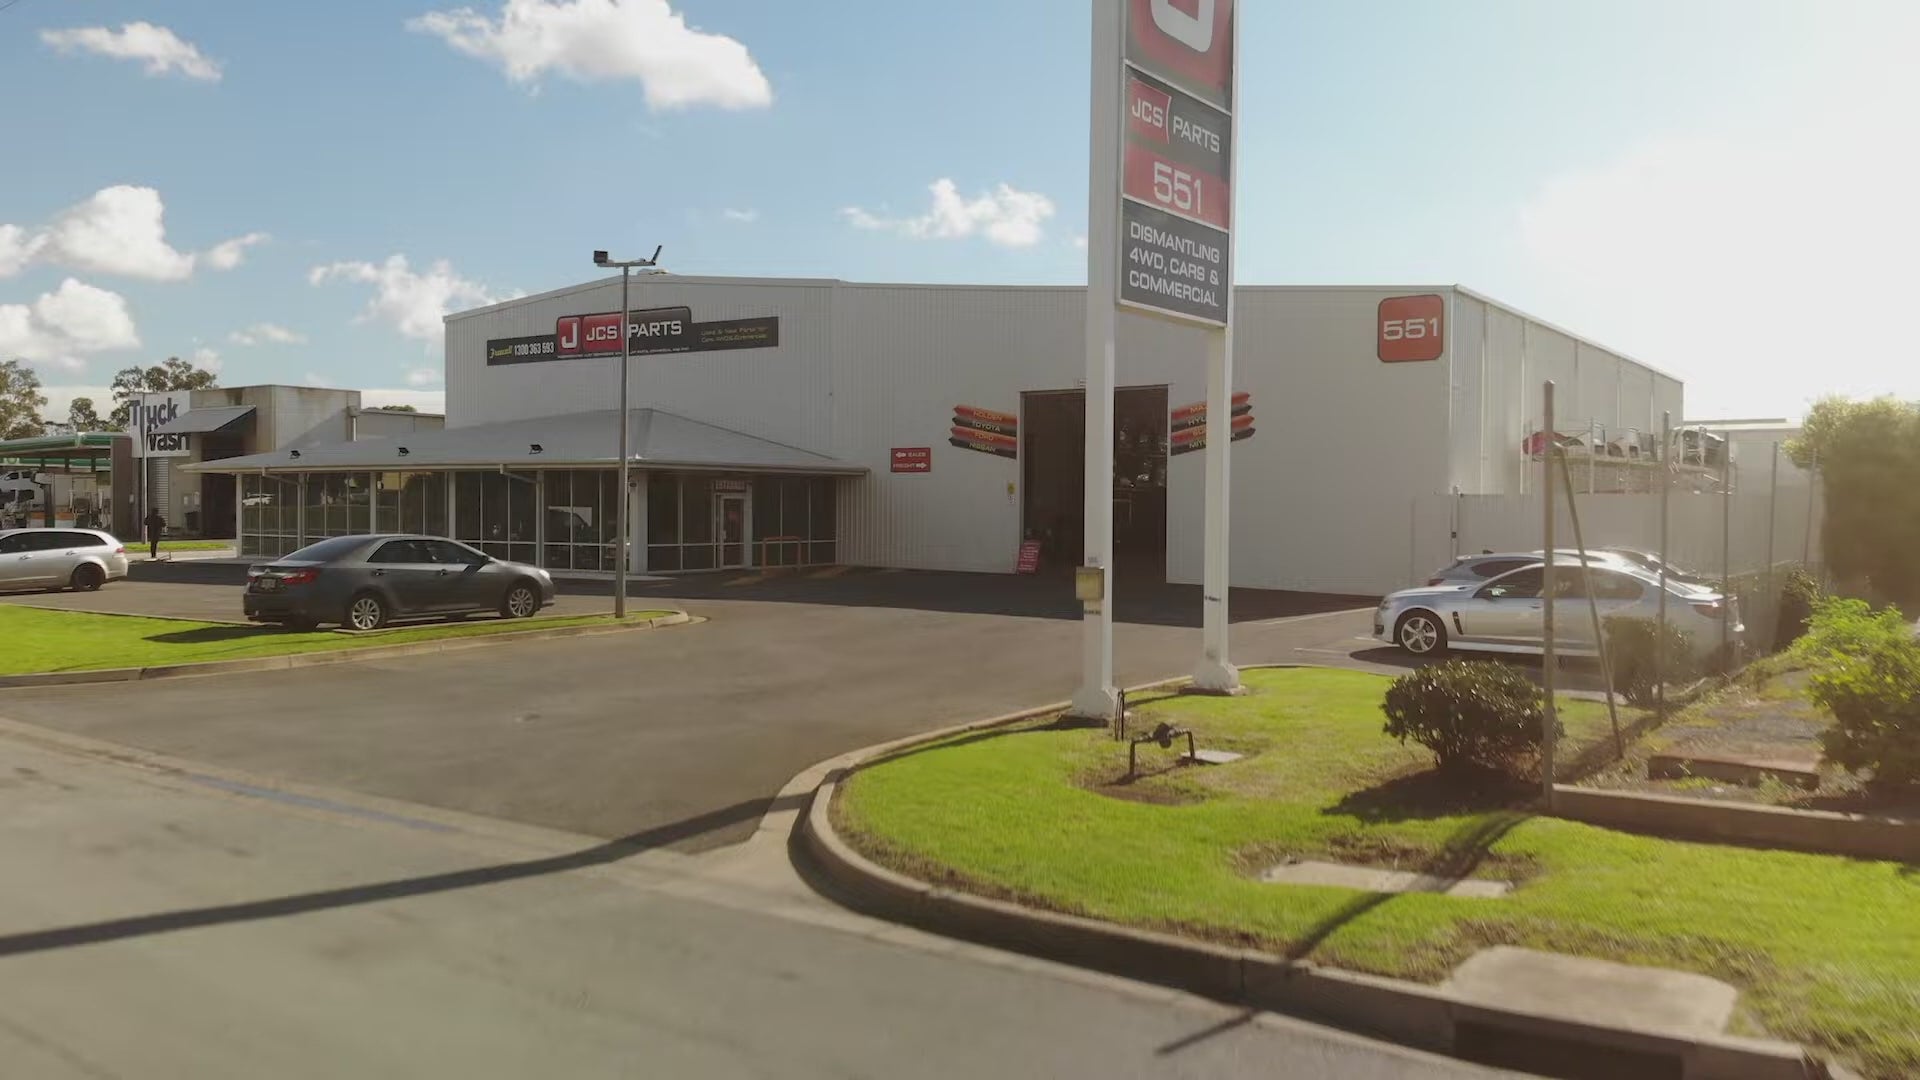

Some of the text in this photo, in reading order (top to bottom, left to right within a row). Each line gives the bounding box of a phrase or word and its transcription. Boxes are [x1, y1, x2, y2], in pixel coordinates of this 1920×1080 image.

[1132, 98, 1220, 153] JCS PARTS
[1154, 161, 1202, 214] 551
[1130, 221, 1220, 263] DISMANTLING
[1129, 247, 1219, 287] 4WD, CARS &
[1129, 270, 1219, 307] COMMERCIAL
[561, 322, 578, 348] J
[586, 325, 618, 341] JCS
[629, 320, 682, 338] PARTS
[1383, 318, 1438, 341] 551
